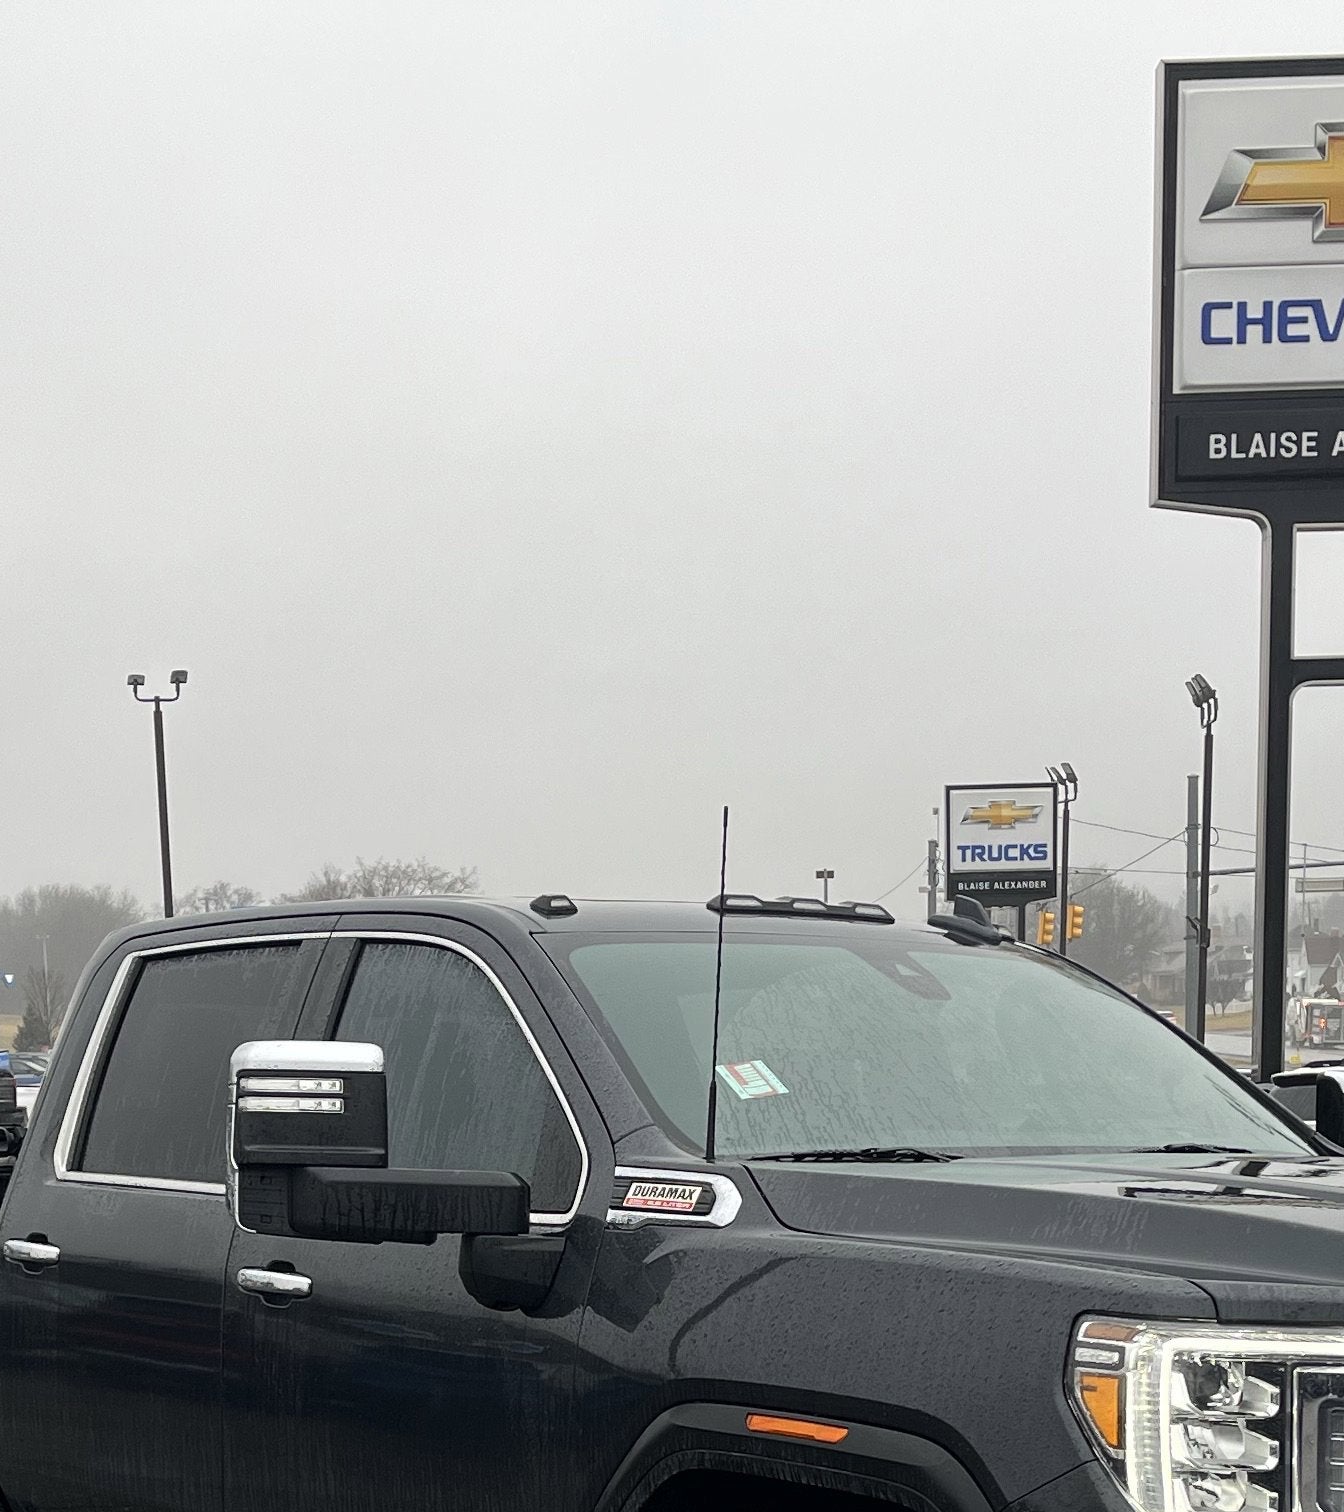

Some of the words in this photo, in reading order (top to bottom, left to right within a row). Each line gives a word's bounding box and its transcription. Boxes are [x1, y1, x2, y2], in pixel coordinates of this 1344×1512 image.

[1208, 431, 1319, 460] BLAISE
[957, 843, 1048, 863] TRUCKS
[958, 881, 990, 891] BLAISE
[993, 880, 1047, 890] ALEXANDER
[632, 1184, 697, 1201] DURAMAX
